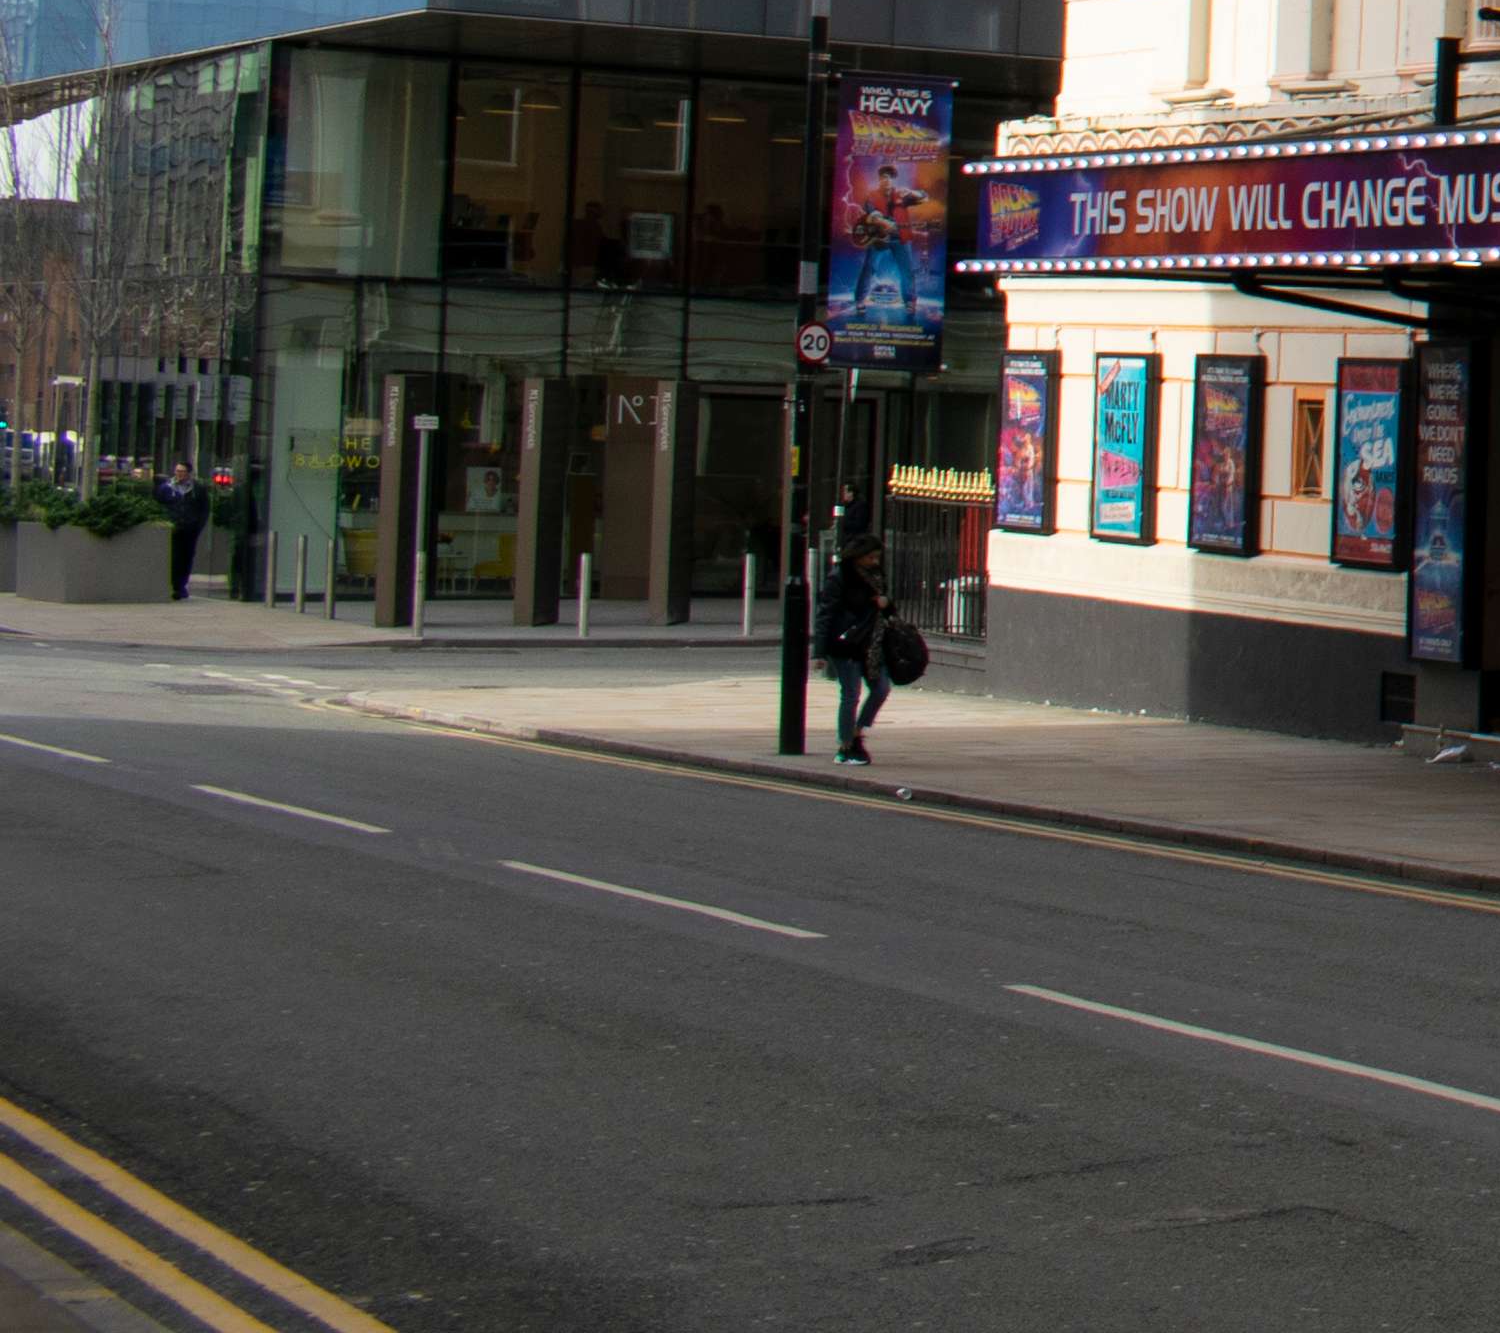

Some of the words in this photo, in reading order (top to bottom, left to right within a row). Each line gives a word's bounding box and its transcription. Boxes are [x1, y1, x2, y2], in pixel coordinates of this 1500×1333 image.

[860, 95, 934, 116] HEAVY
[1069, 190, 1127, 235] THIS
[1135, 186, 1220, 234] SHOW
[1228, 182, 1292, 232] WILL
[1302, 175, 1427, 230] CHANGE
[803, 333, 828, 351] 20
[1105, 381, 1141, 411] MARTY
[1419, 425, 1437, 442] WE
[1360, 436, 1395, 470] SEA
[1428, 445, 1455, 463] NEED
